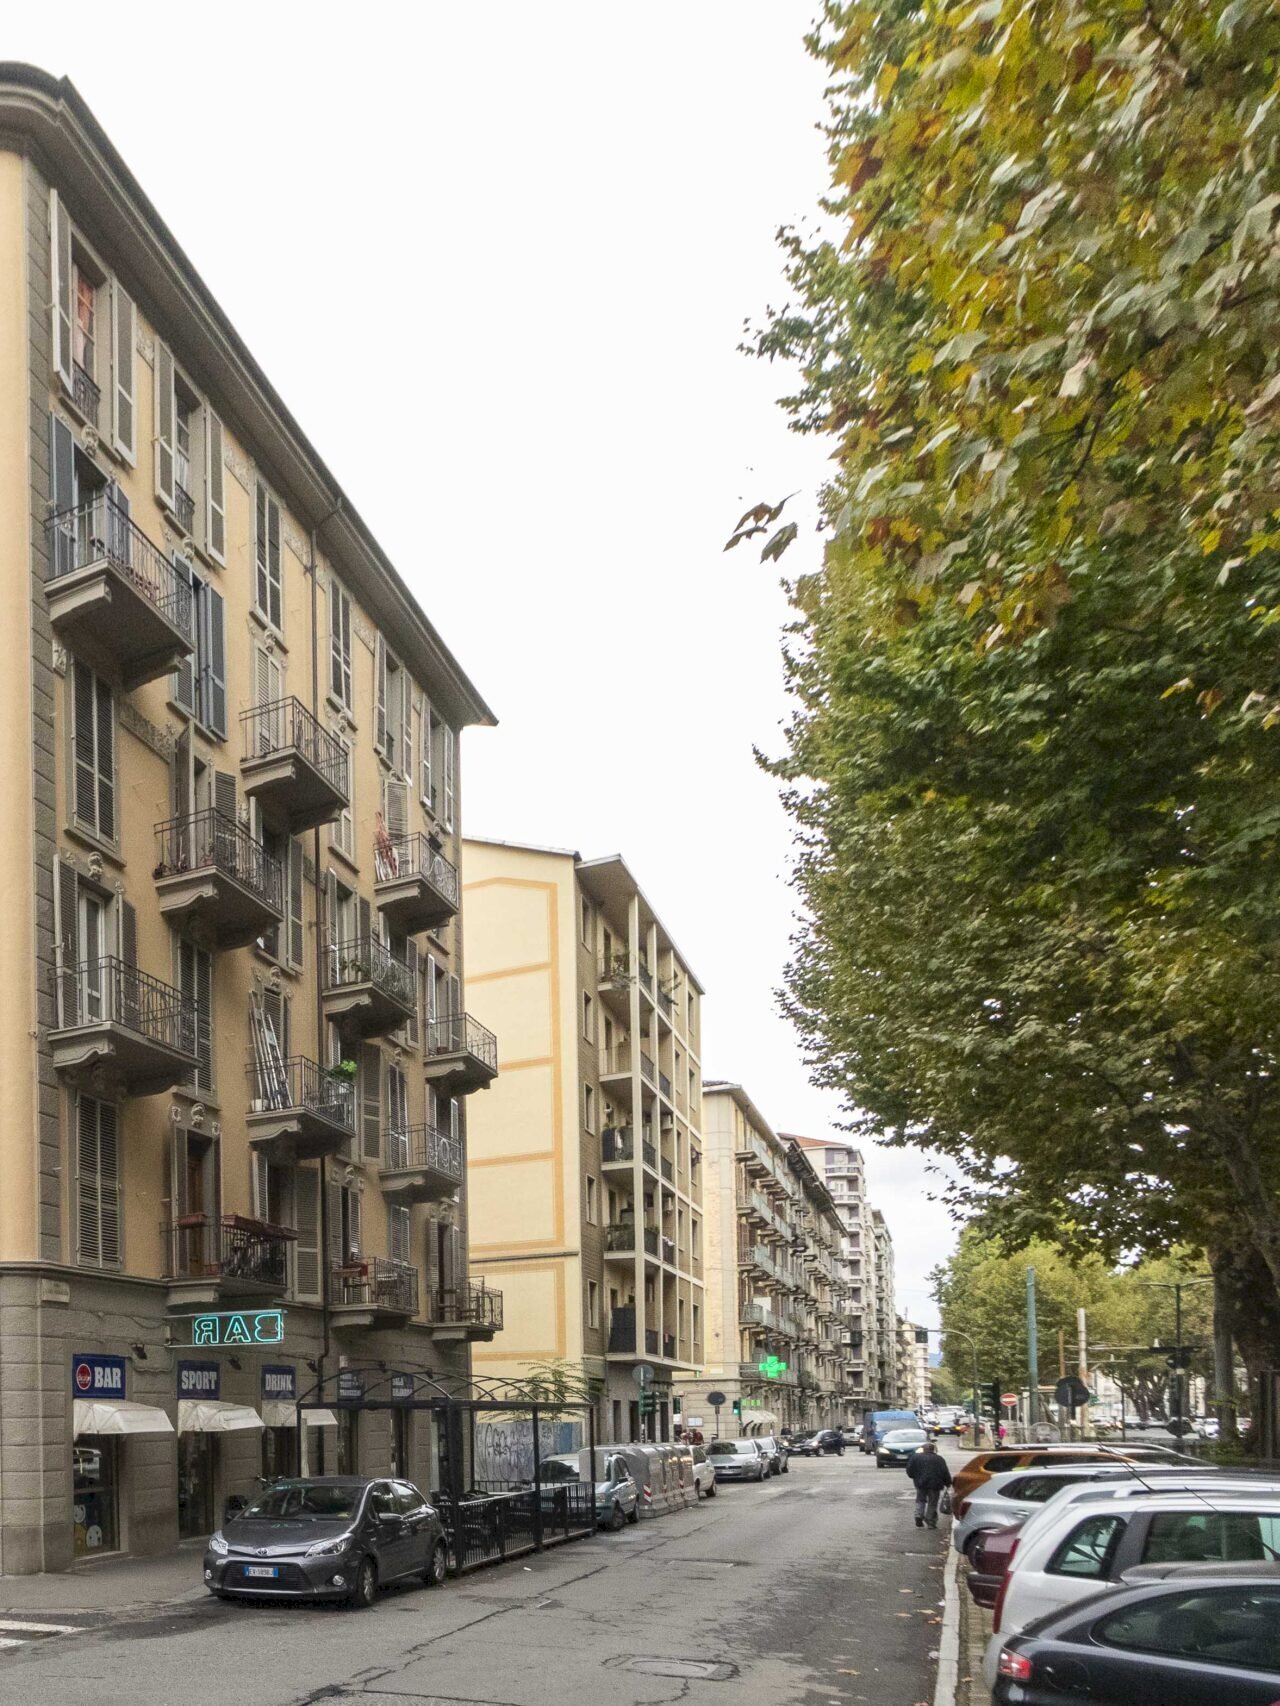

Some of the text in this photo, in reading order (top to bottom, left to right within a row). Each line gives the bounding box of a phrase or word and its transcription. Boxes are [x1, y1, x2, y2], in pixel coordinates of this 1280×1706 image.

[94, 1366, 122, 1388] BAR
[181, 1370, 217, 1390] SPORT
[265, 1374, 293, 1391] DRINK
